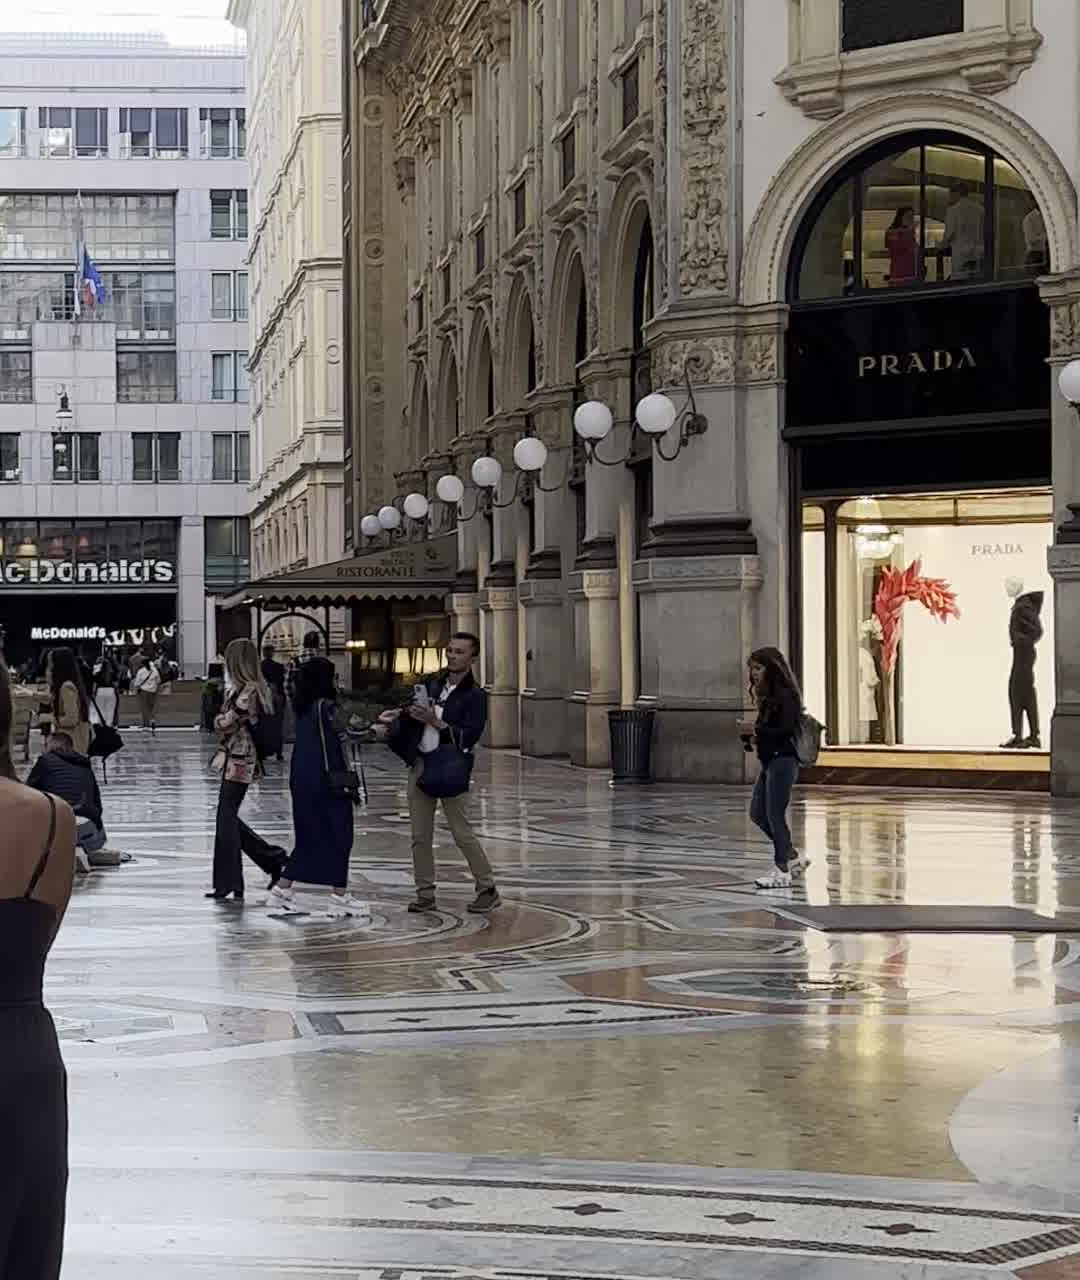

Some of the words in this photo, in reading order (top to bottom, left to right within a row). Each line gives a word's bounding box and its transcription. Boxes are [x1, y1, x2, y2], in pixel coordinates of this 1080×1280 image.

[858, 347, 977, 377] PRADA
[970, 543, 1024, 556] PRADA
[337, 567, 417, 577] RISTORANTE
[31, 627, 106, 639] McDonald's
